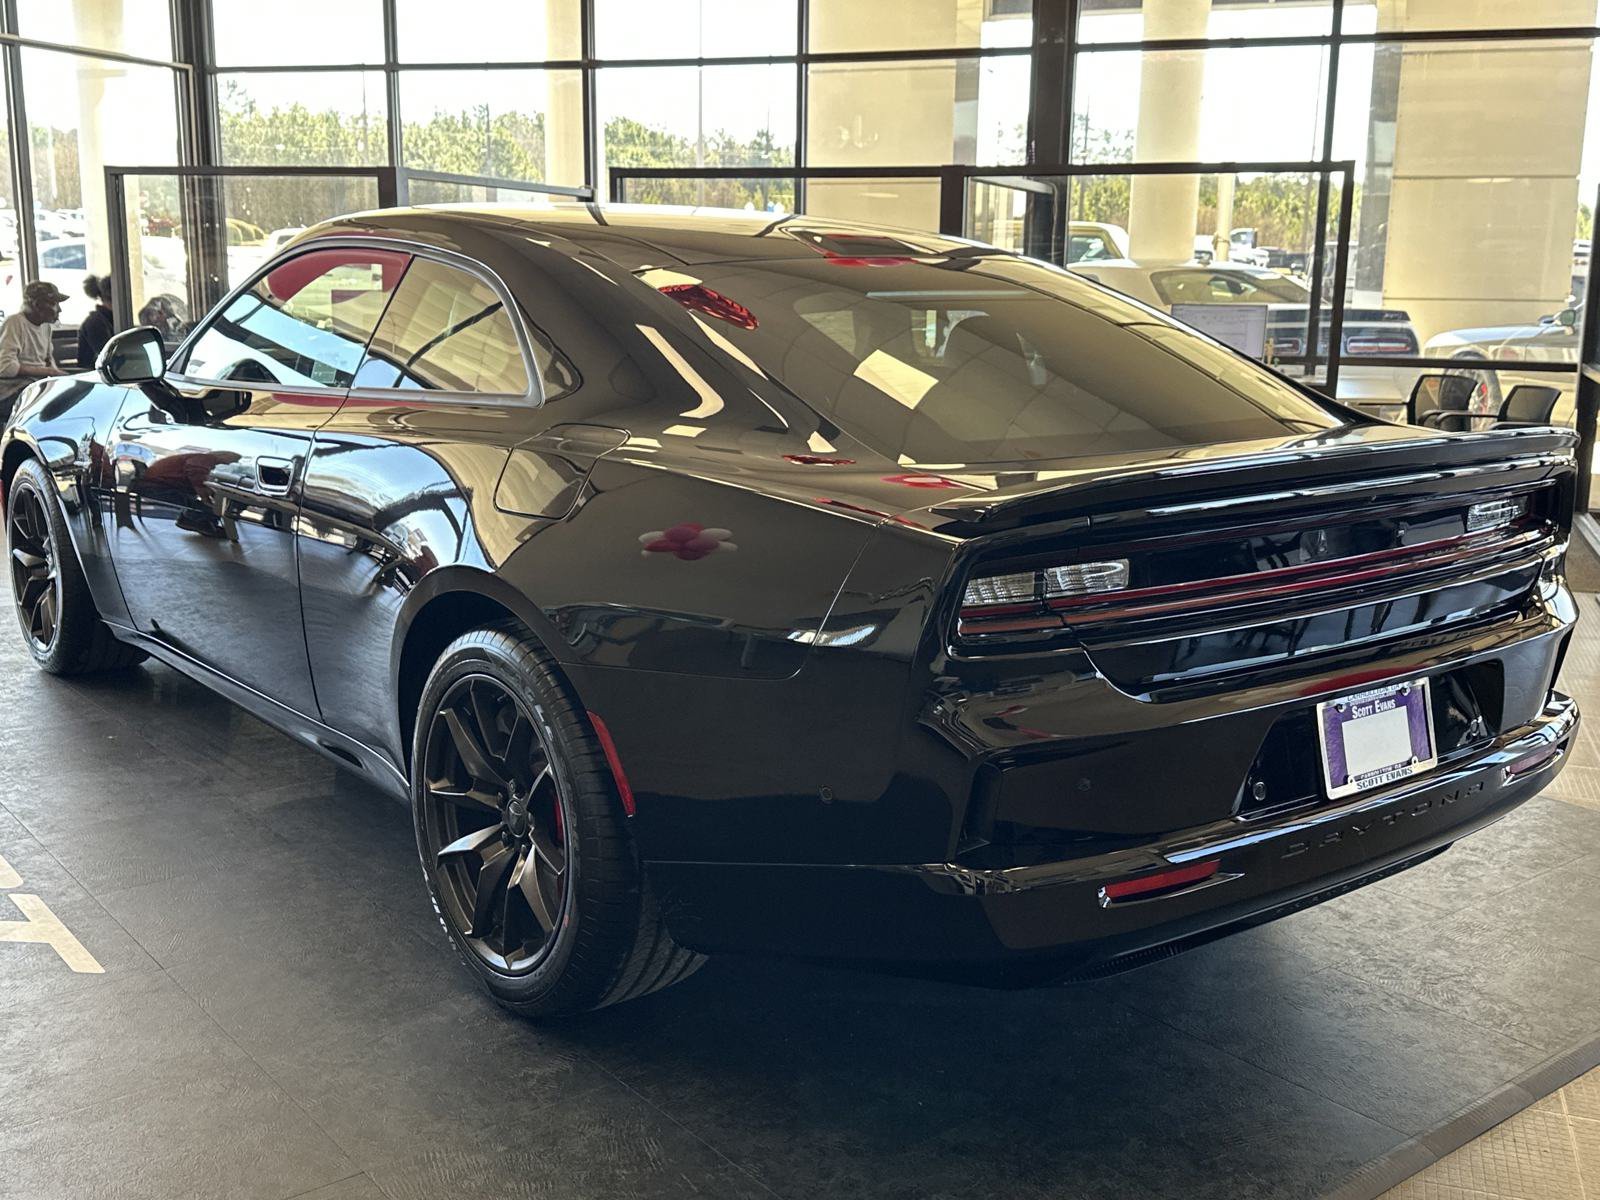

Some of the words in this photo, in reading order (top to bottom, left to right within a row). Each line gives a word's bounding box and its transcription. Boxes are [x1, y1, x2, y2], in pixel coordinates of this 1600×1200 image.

[1357, 775, 1386, 789] SCOTT
[1387, 767, 1413, 779] EVANS
[1280, 781, 1485, 859] DAYTONA
